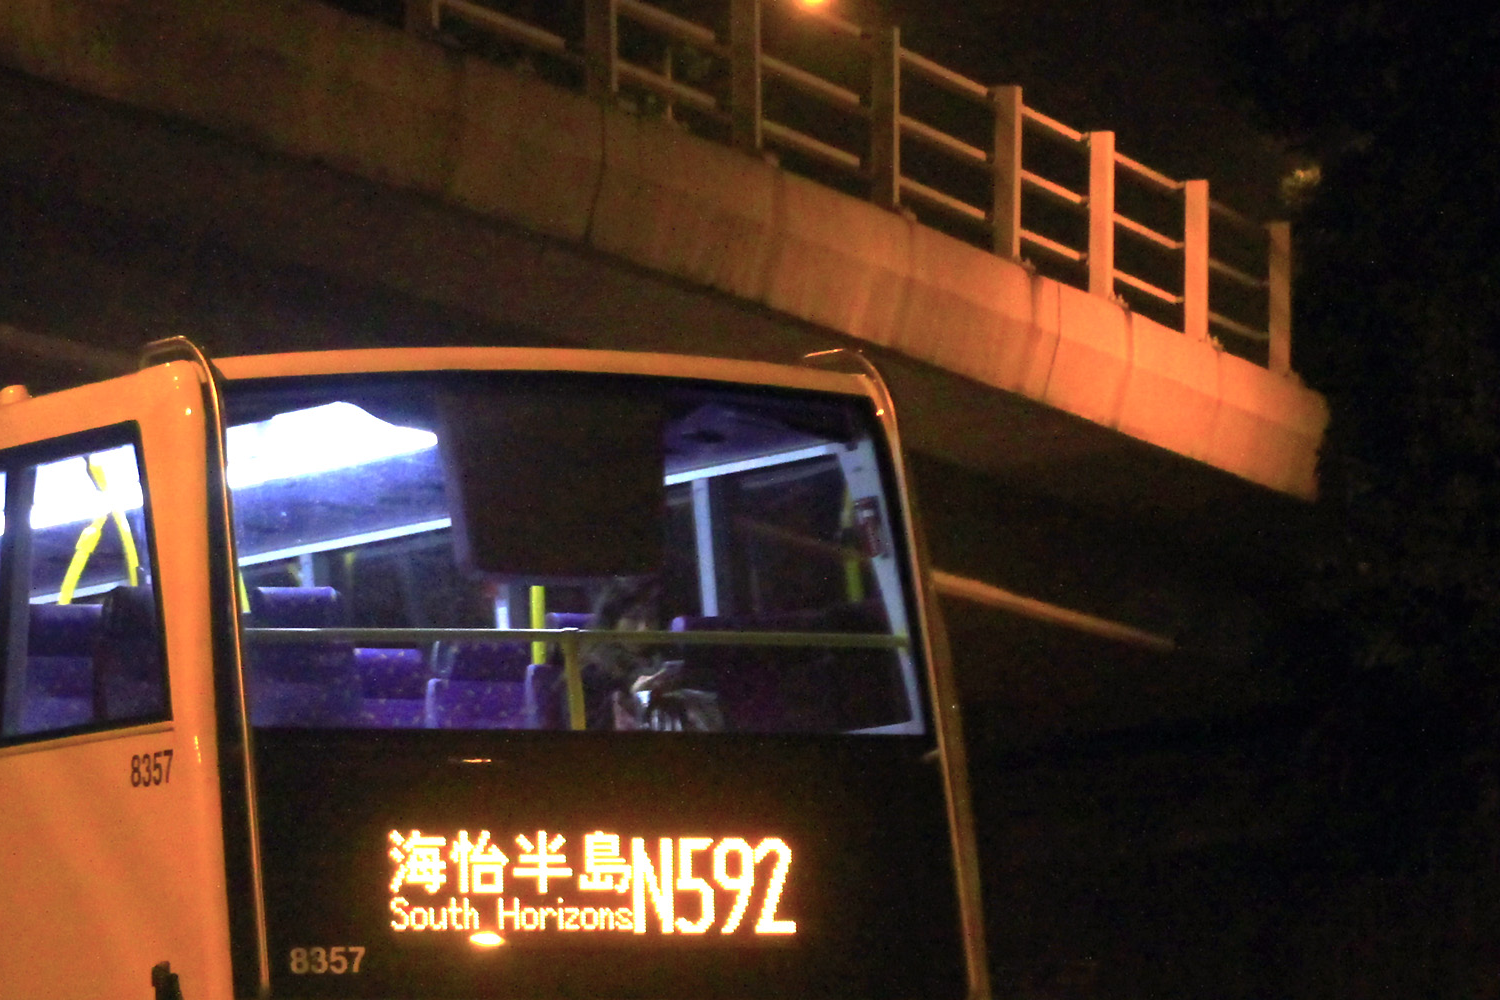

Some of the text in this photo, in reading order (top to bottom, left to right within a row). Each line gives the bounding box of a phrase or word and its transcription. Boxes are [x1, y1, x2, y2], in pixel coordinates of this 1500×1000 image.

[130, 749, 174, 788] 8357
[388, 829, 632, 895] 海怡半島
[631, 836, 798, 934] N592
[389, 896, 634, 932] South Horizons
[289, 945, 367, 975] 8357
